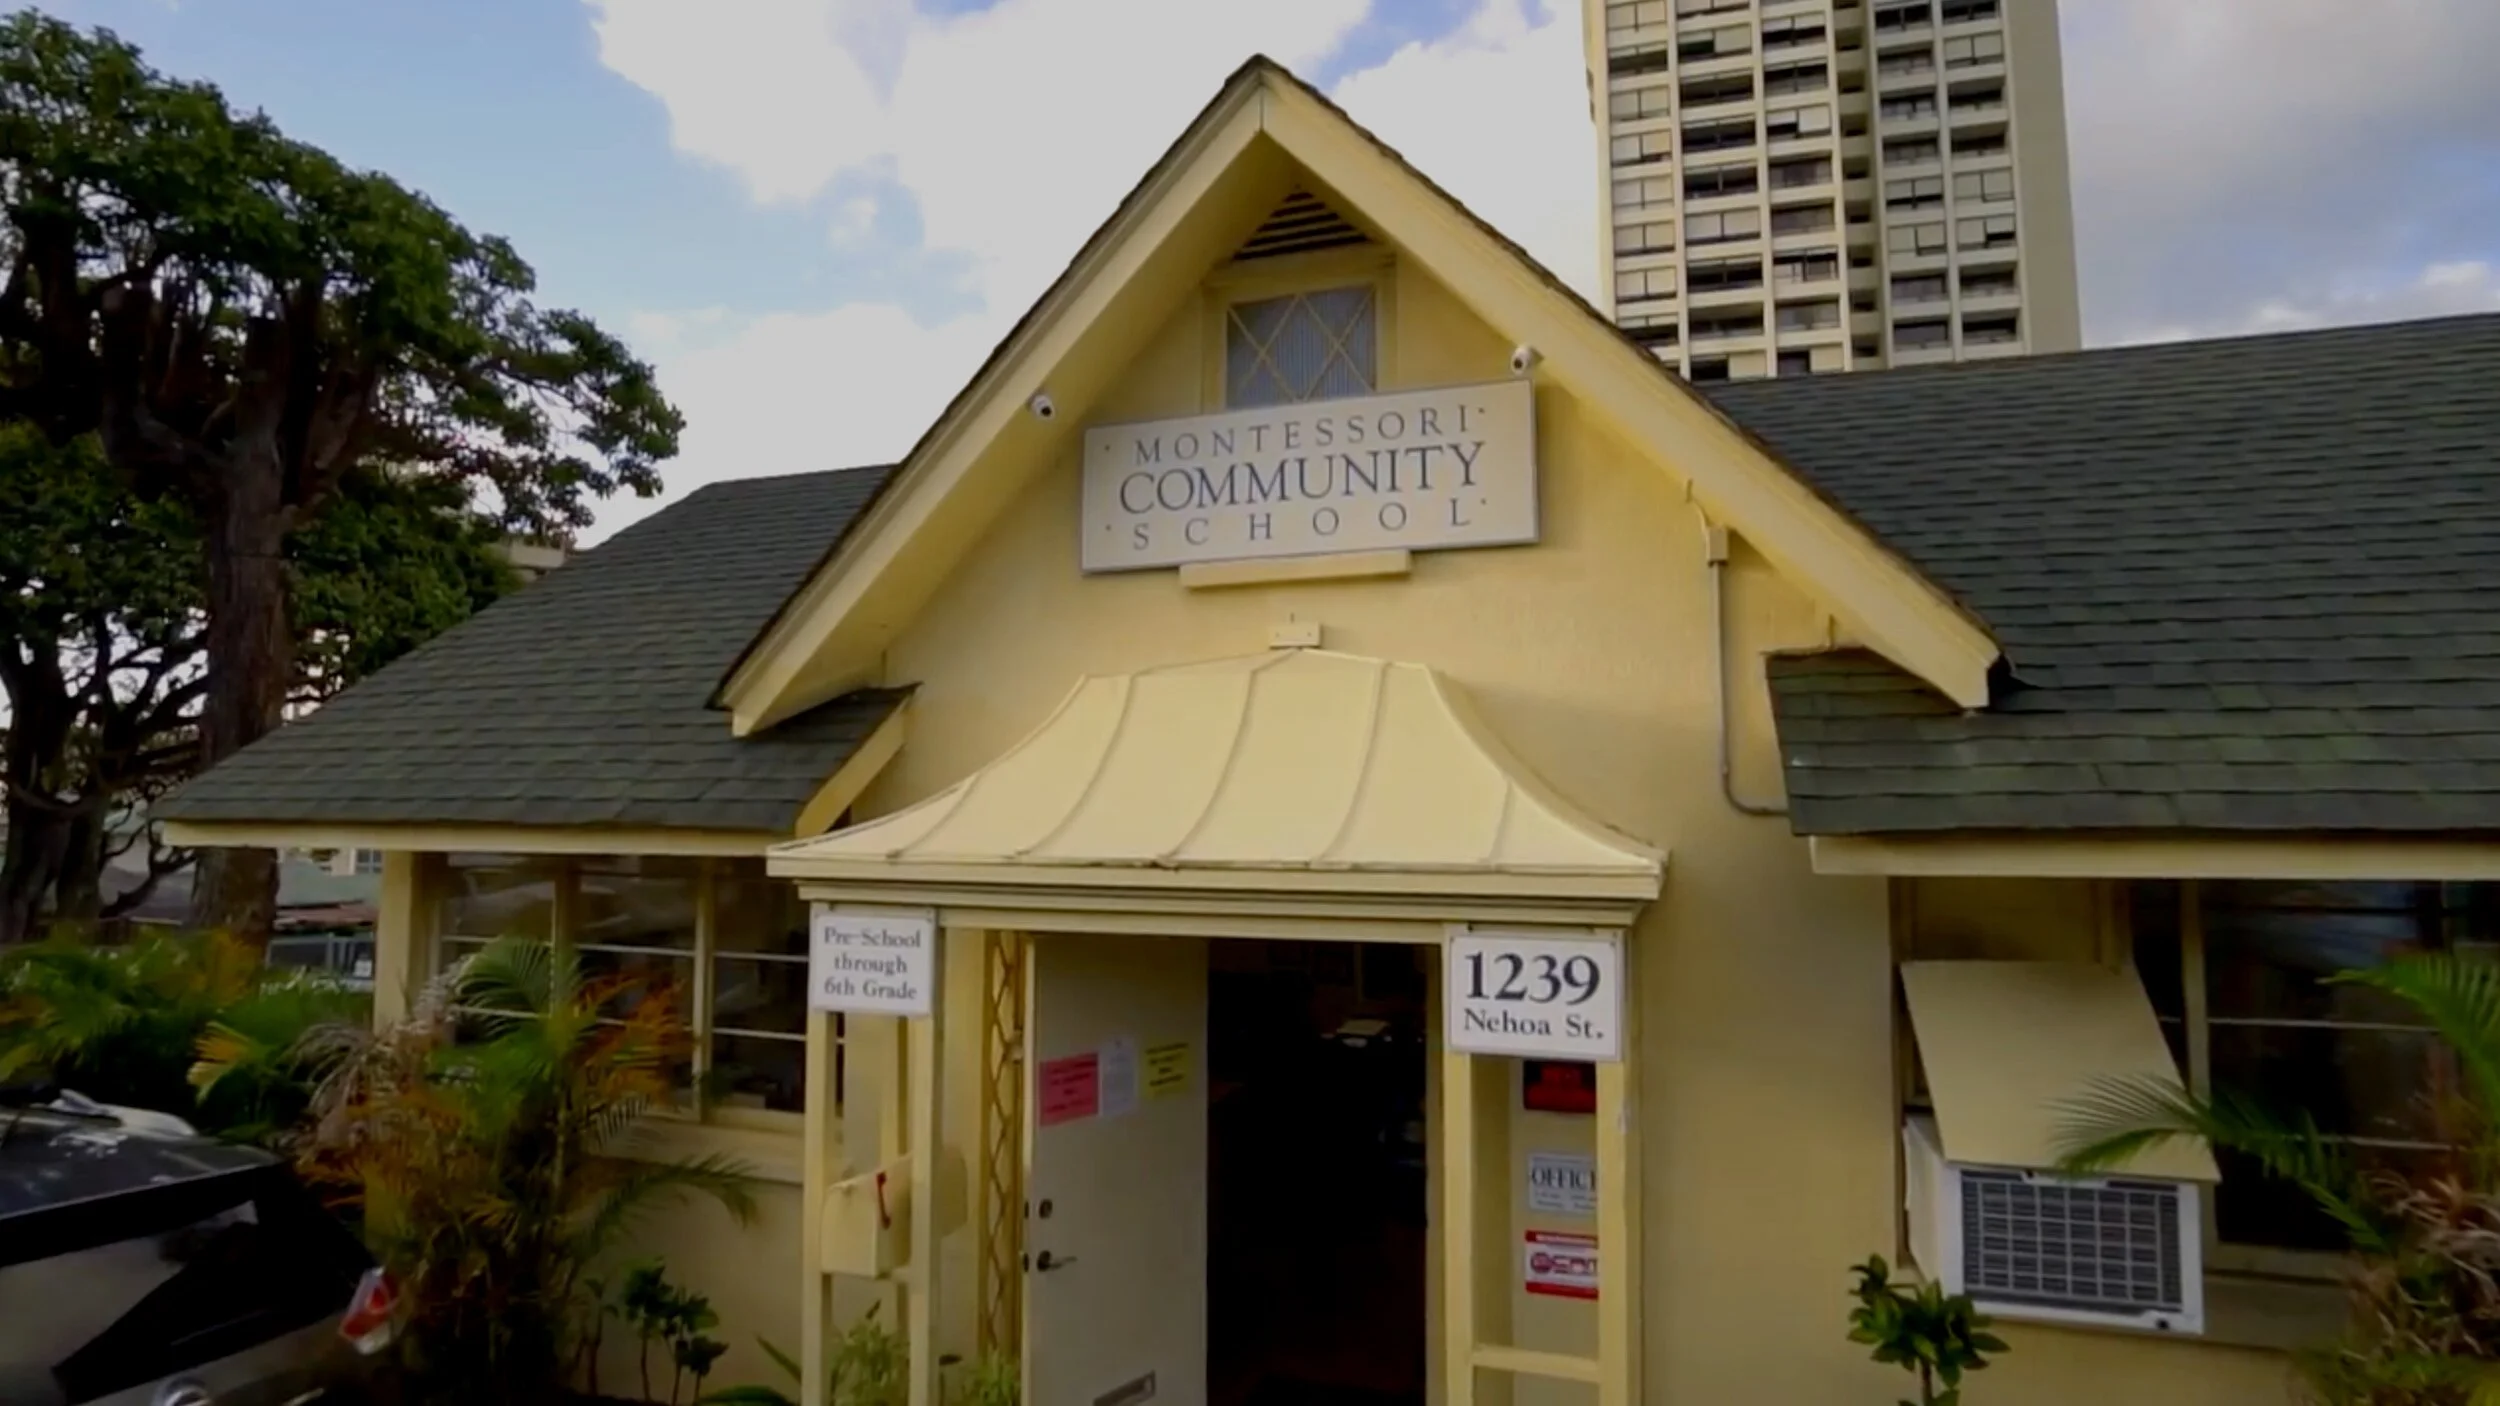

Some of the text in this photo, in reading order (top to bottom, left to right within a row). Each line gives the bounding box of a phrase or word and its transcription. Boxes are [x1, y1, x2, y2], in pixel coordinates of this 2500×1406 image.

[1135, 404, 1468, 466] MONTESSORI
[1119, 441, 1485, 515] COMMUNITY
[1133, 499, 1471, 551] SCHOOL
[824, 976, 917, 1000] 6th Grade
[834, 952, 908, 976] through
[1464, 951, 1601, 1006] 1239
[1463, 1007, 1604, 1040] Nehoa St.
